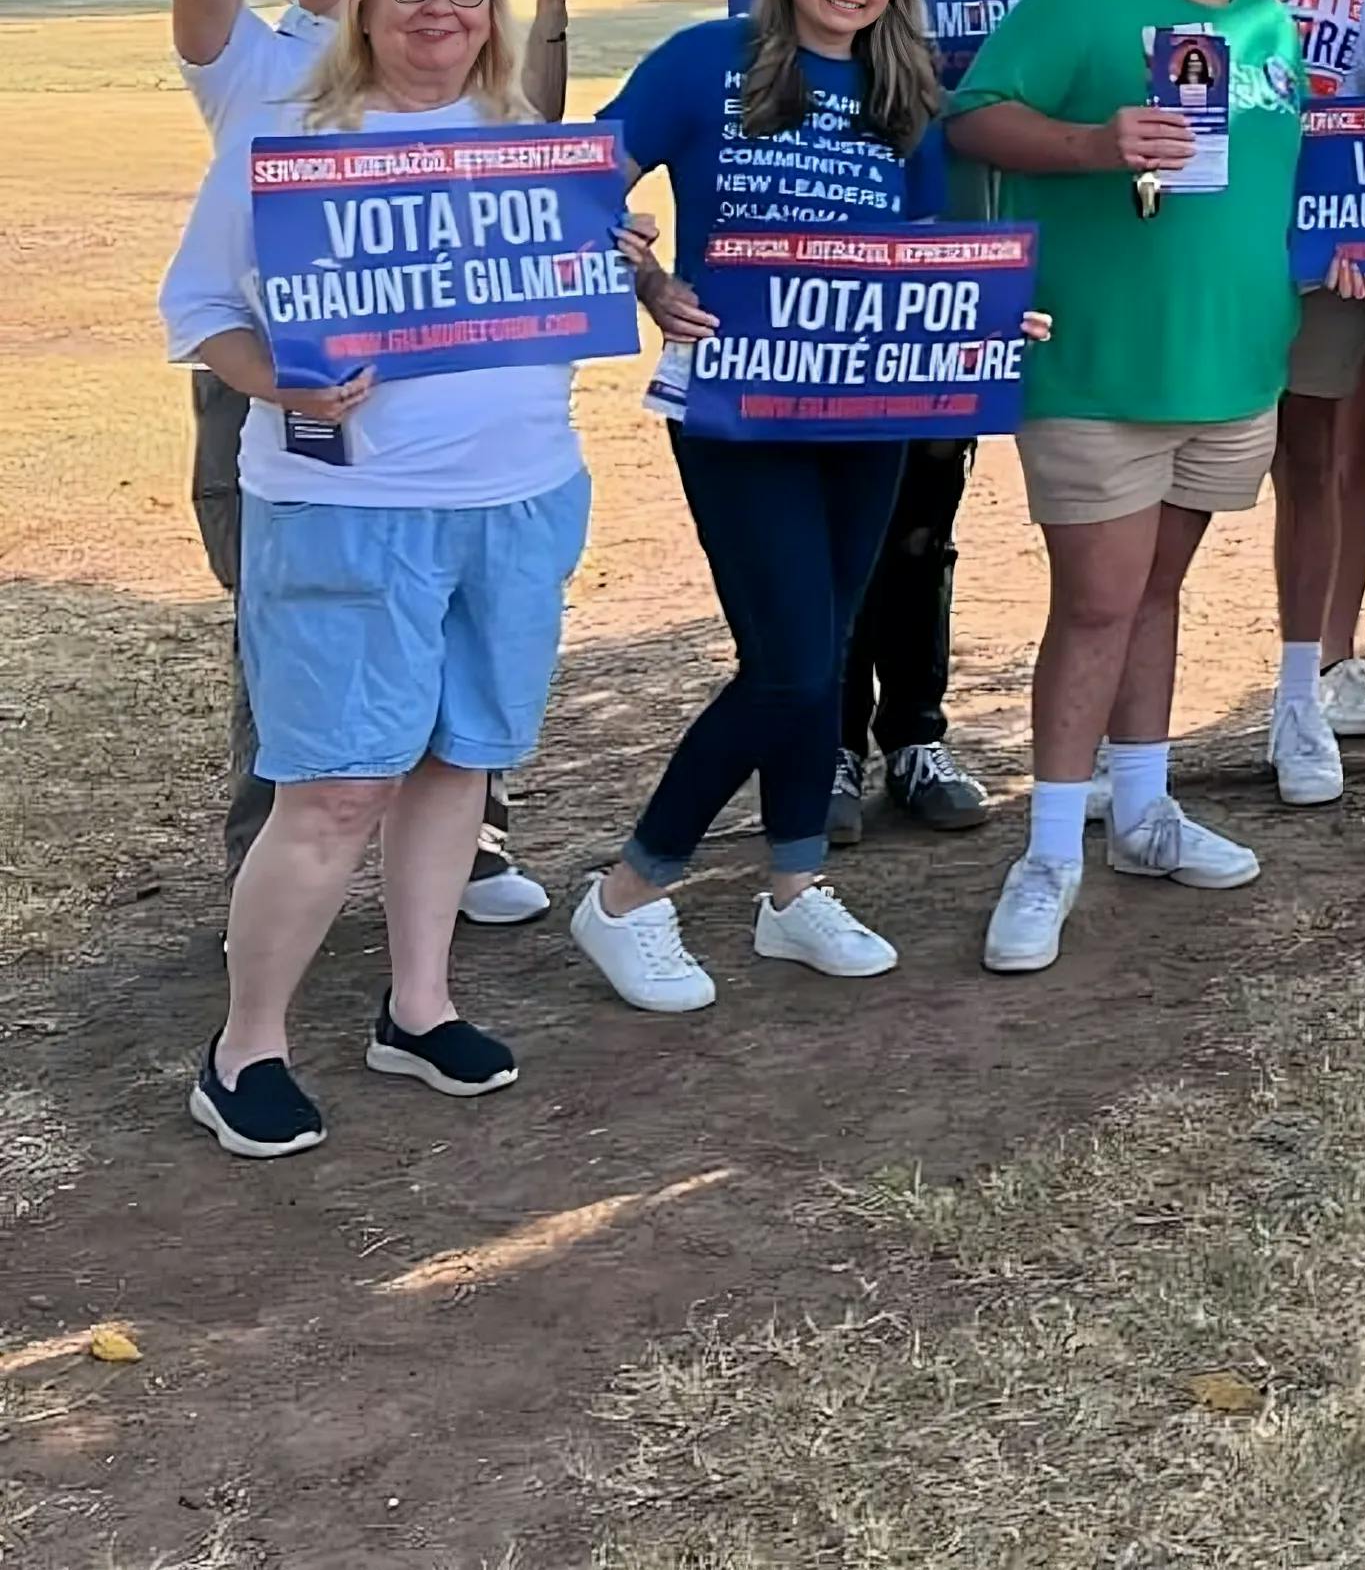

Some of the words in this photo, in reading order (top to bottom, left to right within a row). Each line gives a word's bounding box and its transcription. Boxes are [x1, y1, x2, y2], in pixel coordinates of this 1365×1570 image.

[719, 147, 862, 178] COMMUNITY
[716, 173, 772, 193] NEW
[778, 177, 888, 209] LEADERS
[322, 192, 462, 259] VOTA
[468, 187, 562, 247] POR
[266, 253, 456, 322] CHAUNTÉ
[464, 249, 630, 305] GILMORE
[769, 276, 883, 333] VOTA
[895, 281, 980, 331] POR
[695, 333, 868, 385] CHAUNTÉ
[874, 338, 1026, 382] GILMORE
